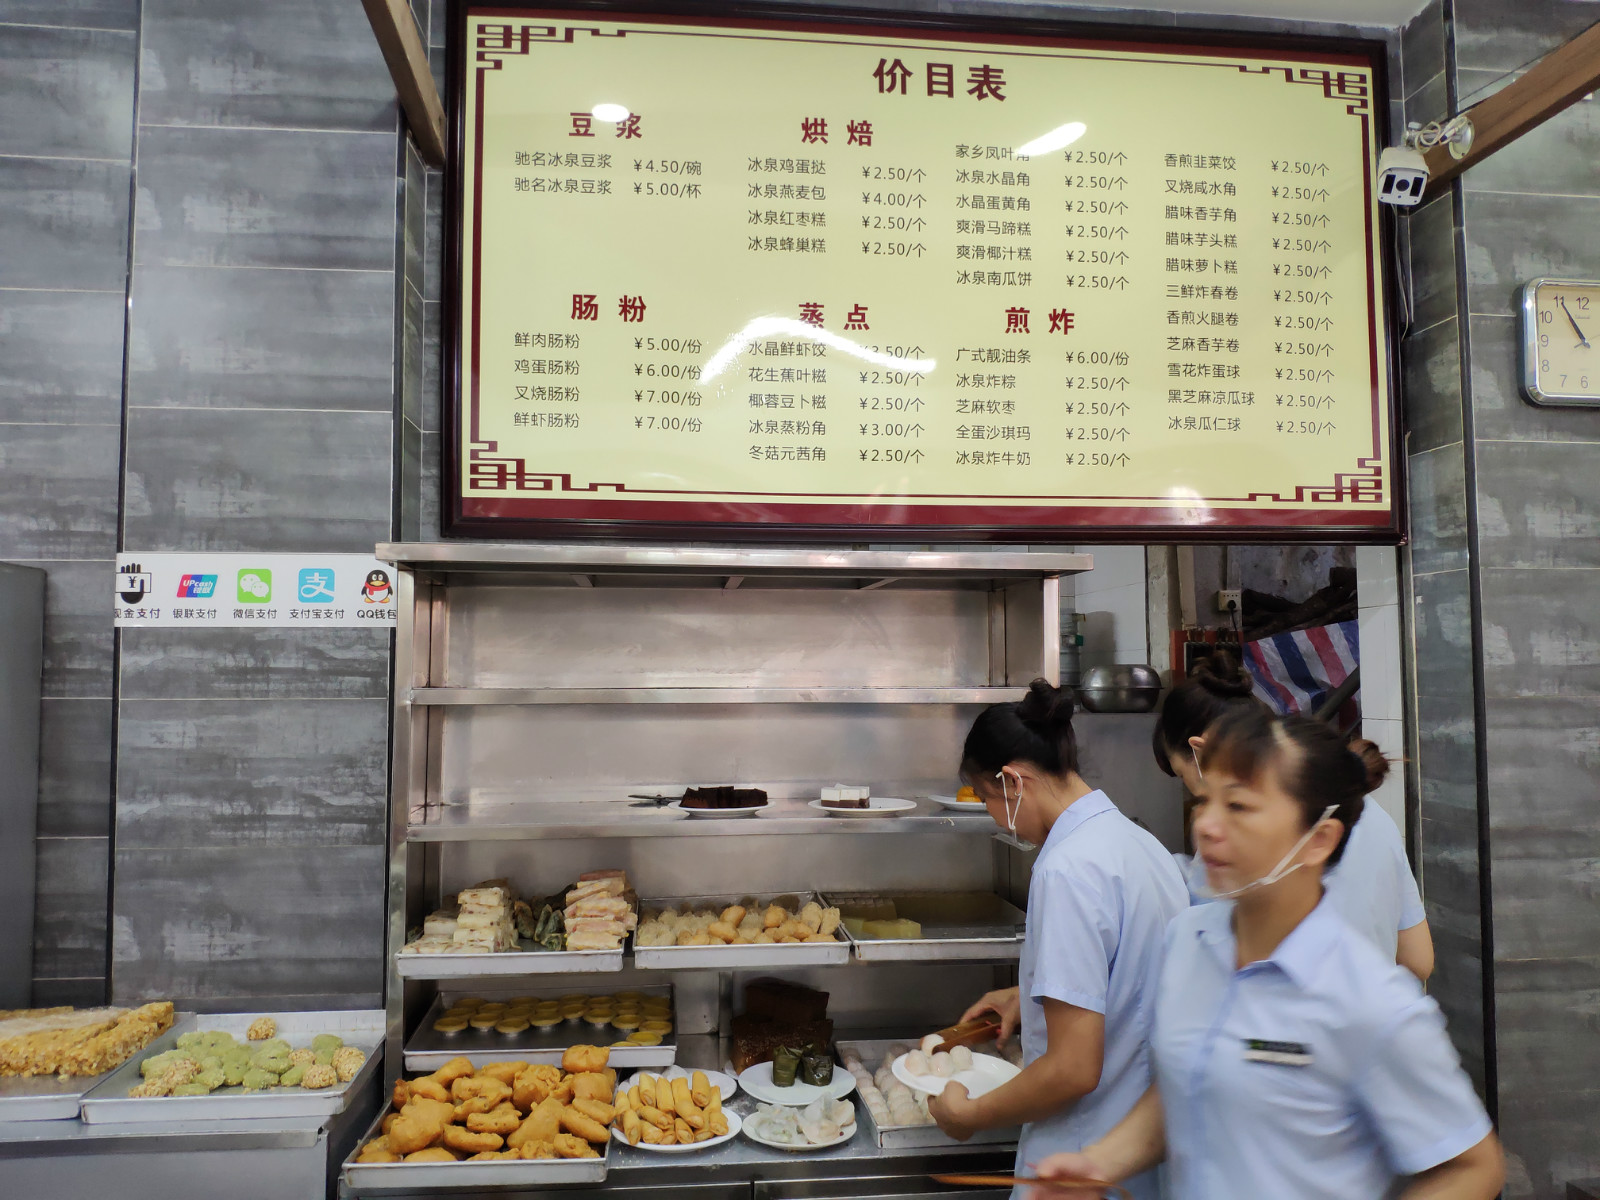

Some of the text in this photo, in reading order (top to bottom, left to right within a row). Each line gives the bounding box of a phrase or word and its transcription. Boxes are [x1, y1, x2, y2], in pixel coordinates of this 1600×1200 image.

[873, 58, 1006, 101] 价目表
[569, 113, 642, 139] 豆浆
[801, 117, 873, 147] 烘焙
[515, 152, 701, 175] 驰名冰泉豆浆 ¥4.50/碗
[1065, 151, 1127, 165] ¥2.50/个
[1165, 154, 1329, 176] 香煎韭菜饺 ¥2.50/个
[748, 157, 926, 183] 冰泉鸡蛋挞 ¥2.50/个
[956, 169, 1128, 190] 冰泉水晶角 ¥2.50/个
[515, 177, 701, 198] 驰名冰泉豆浆 ¥5.00/杯
[748, 183, 926, 208] 冰泉燕麦包 ¥4.00/个
[1165, 180, 1329, 202] 叉烧咸水角 ¥2.50/个
[956, 194, 1128, 215] 水晶蛋黄角 ¥2.50/个
[748, 210, 926, 232] 冰泉红枣糕 ¥2.50/个
[1165, 205, 1330, 228] 腊味香芋角 ¥2.50/个
[957, 219, 1128, 240] 爽滑马蹄糕 ¥2.50/个
[748, 236, 926, 258] 冰泉蜂巢糕 ¥2.50/个
[1166, 231, 1331, 253] 腊味芋头糕 ¥2.50/个
[956, 245, 1129, 265] 爽滑椰汁糕 ¥2.50/个
[1166, 258, 1332, 279] 腊味萝卜糕 ¥2.50/个
[957, 270, 1129, 290] 冰泉南瓜饼 ¥2.50/个
[1166, 284, 1332, 305] 三鲜炸春卷 ¥2.50/个
[1576, 297, 1589, 310] 12
[571, 294, 646, 322] 肠粉
[799, 302, 870, 330] 蒸点
[1540, 311, 1552, 323] 10
[1005, 307, 1075, 335] 煎炸
[1167, 311, 1333, 331] 香煎火腿卷 ¥2.50/个
[515, 332, 702, 353] 鲜肉肠粉 ¥5.00/份
[749, 342, 925, 360] 水晶鲜虾饺 350/个
[1167, 337, 1334, 357] 芝麻香芋卷 ¥2.50/个
[1541, 335, 1548, 347] 9
[956, 348, 1129, 365] 广式靓油条 ¥6.00/份
[1542, 360, 1549, 372] 8
[515, 359, 701, 380] 鸡蛋肠粉 ¥6.00/份
[860, 372, 925, 386] ¥2.50/个
[1168, 363, 1334, 383] 雪花炸蛋球 ¥2.50/个
[956, 373, 1129, 391] 冰泉炸粽 ¥2.50/个
[1560, 375, 1567, 387] 7
[1581, 376, 1588, 388] 6
[515, 386, 702, 406] 叉烧肠粉 ¥7.00/份
[860, 398, 925, 412] ¥2.50/个
[1168, 390, 1335, 409] 黑芝麻凉瓜球 ¥2.50/个
[956, 399, 1130, 416] 芝麻软枣 ¥2.50/个
[514, 412, 702, 432] 鲜虾肠粉 ¥7.00/份
[749, 419, 925, 438] 冰泉蒸粉角 ¥3.00/个
[1169, 416, 1336, 435] 冰泉瓜仁球 ¥2.50/个
[956, 425, 1130, 441] 全蛋沙琪玛 ¥2.50/个
[749, 445, 924, 464] 冬菇元茜角 ¥2.50/个
[956, 450, 1130, 467] 冰泉炸牛奶 ¥2.50/个
[173, 609, 216, 619] 银联支付
[233, 609, 277, 619] 微信支付
[290, 609, 344, 619] 支付宝支付
[357, 609, 396, 619] QQ钱包
